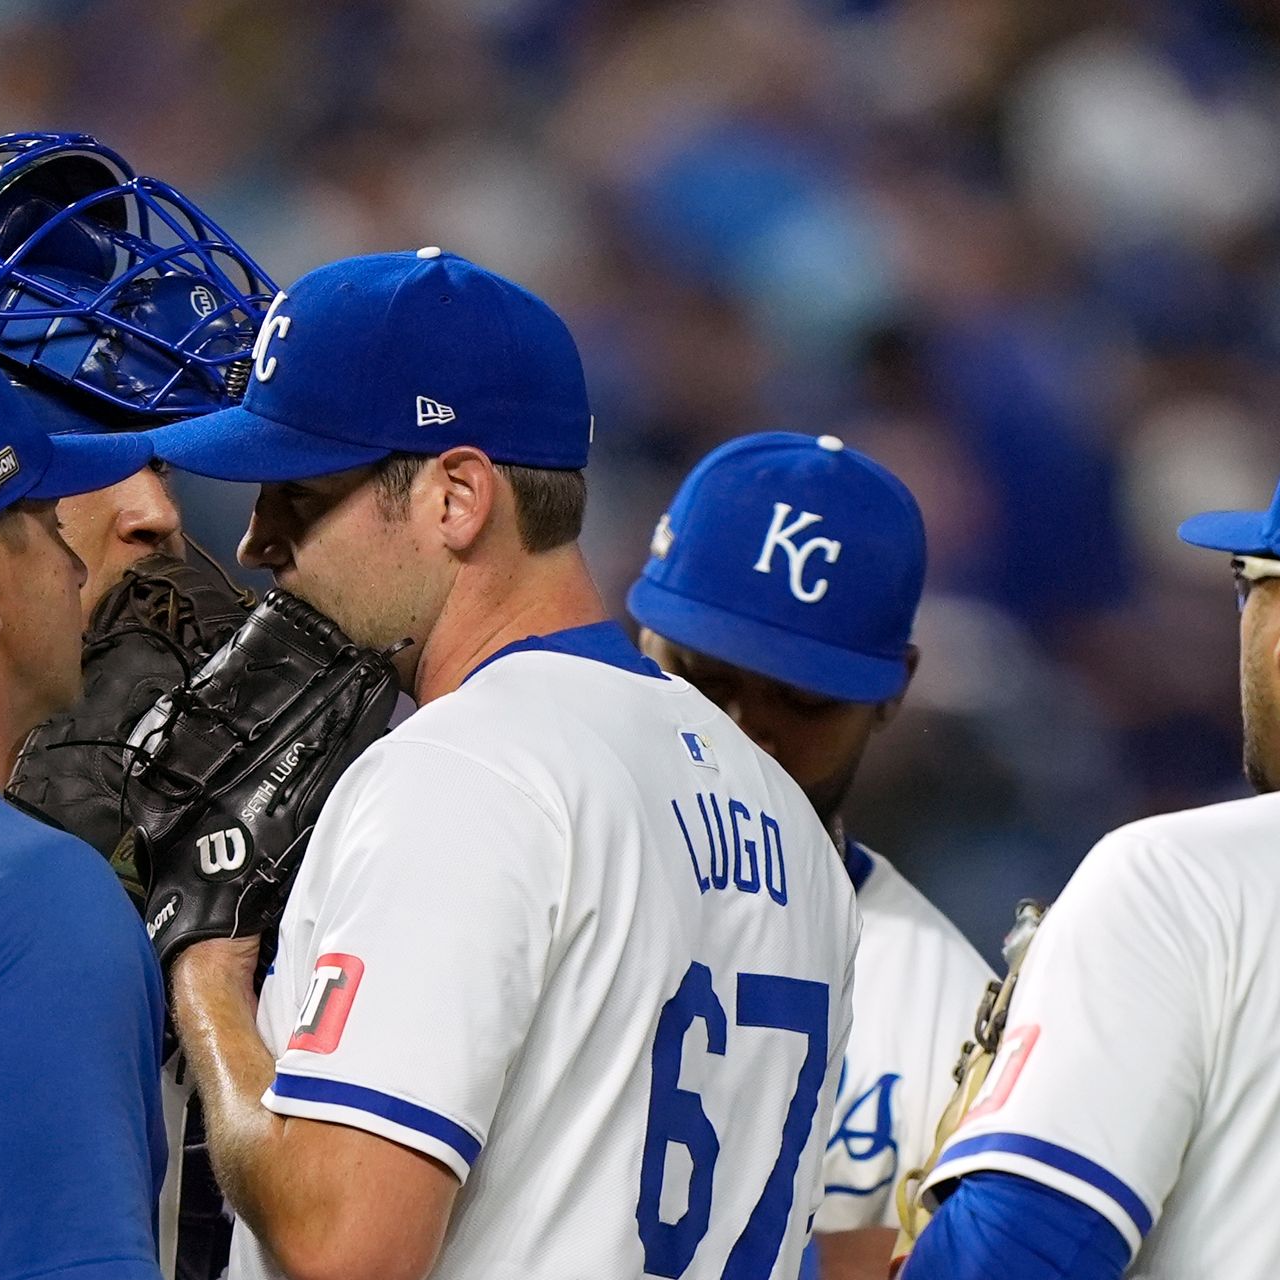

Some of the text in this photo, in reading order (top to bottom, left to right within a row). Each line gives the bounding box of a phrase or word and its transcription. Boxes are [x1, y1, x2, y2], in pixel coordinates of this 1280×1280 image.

[752, 502, 841, 603] KC
[241, 780, 277, 822] SETH
[671, 792, 787, 907] LUGO
